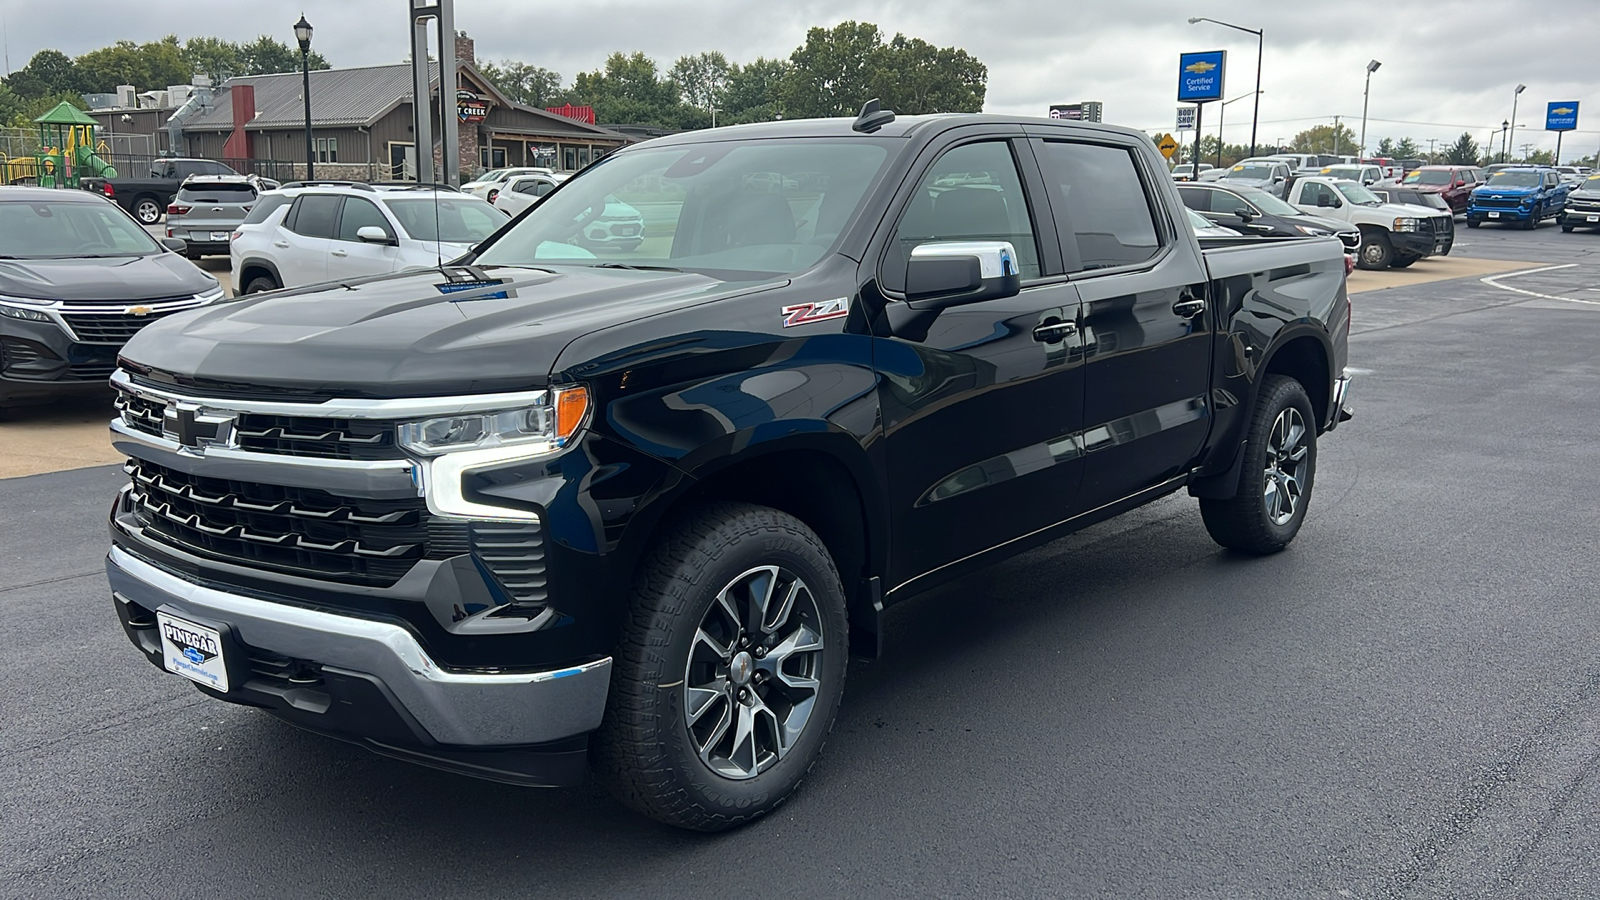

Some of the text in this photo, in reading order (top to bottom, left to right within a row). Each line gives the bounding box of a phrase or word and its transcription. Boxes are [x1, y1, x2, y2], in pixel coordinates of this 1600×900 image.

[1186, 77, 1214, 86] Certified
[463, 108, 486, 116] CREEK
[1177, 116, 1195, 124] SHOP
[781, 297, 849, 328] Z71
[163, 623, 219, 656] PINEGAR
